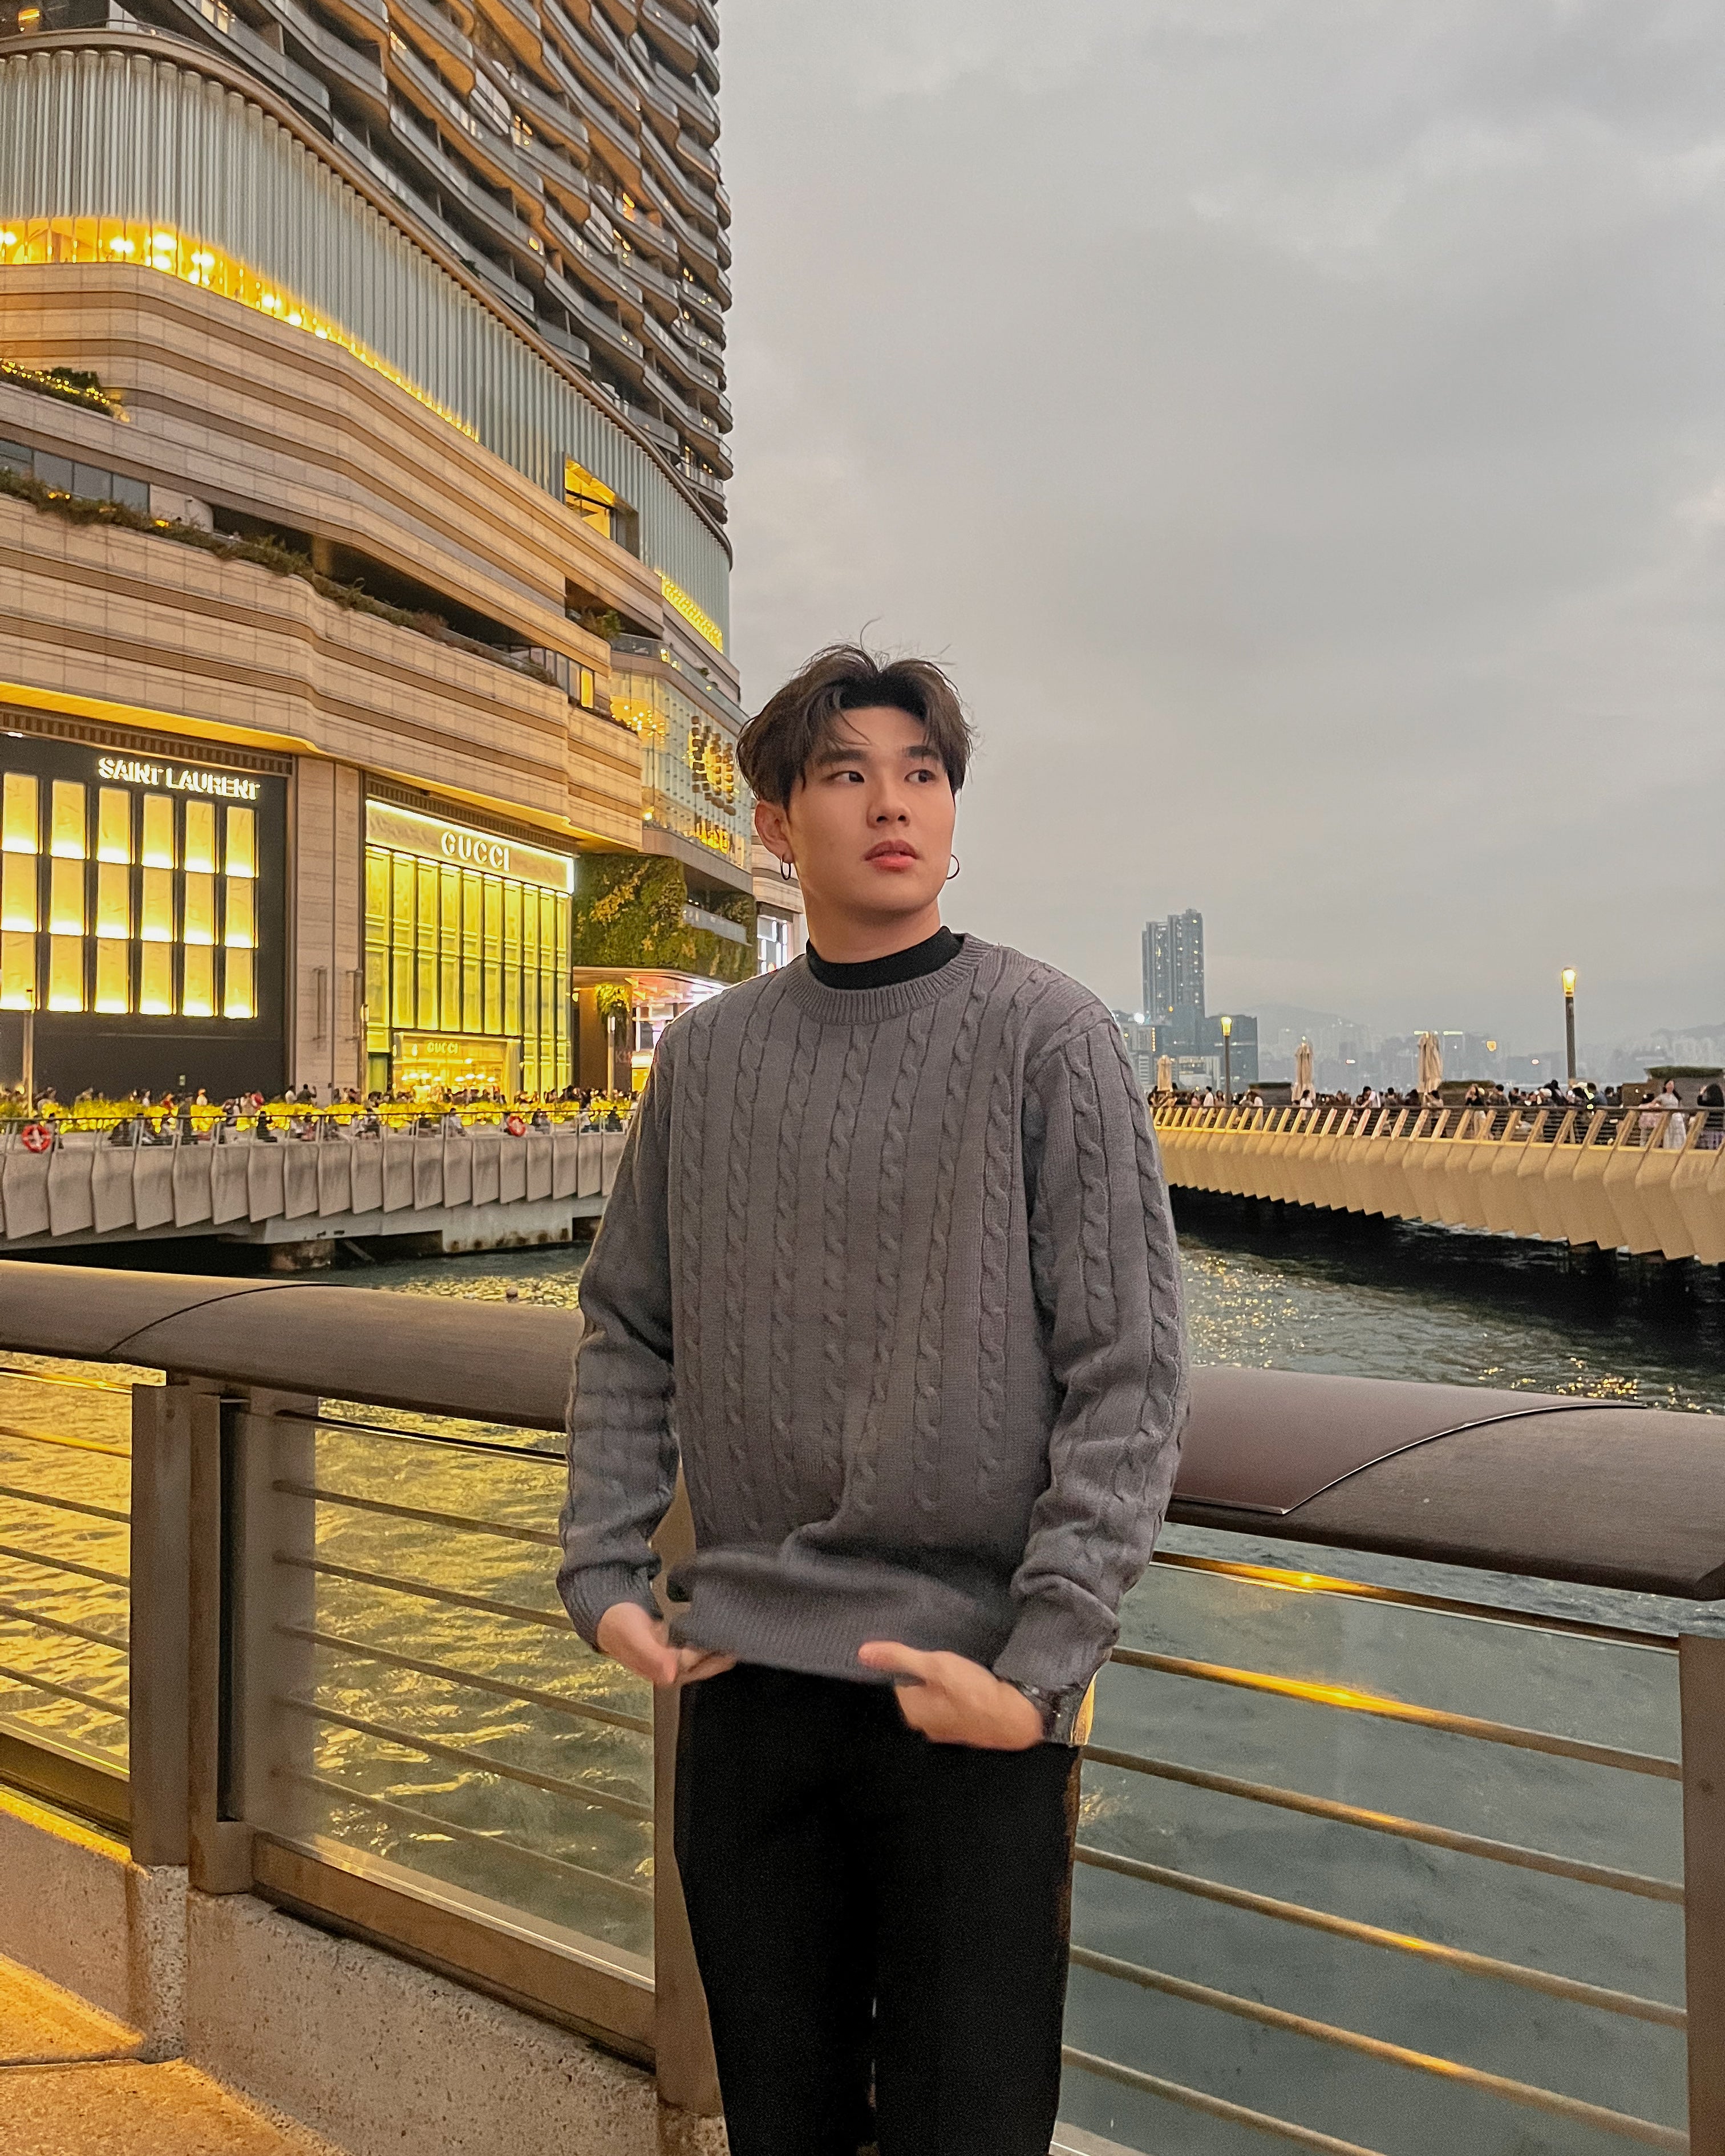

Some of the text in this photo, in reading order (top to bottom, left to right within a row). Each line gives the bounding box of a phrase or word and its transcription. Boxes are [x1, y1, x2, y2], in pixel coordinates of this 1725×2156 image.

[99, 757, 261, 800] SAINT LAURENT
[441, 831, 510, 872] GUCCI
